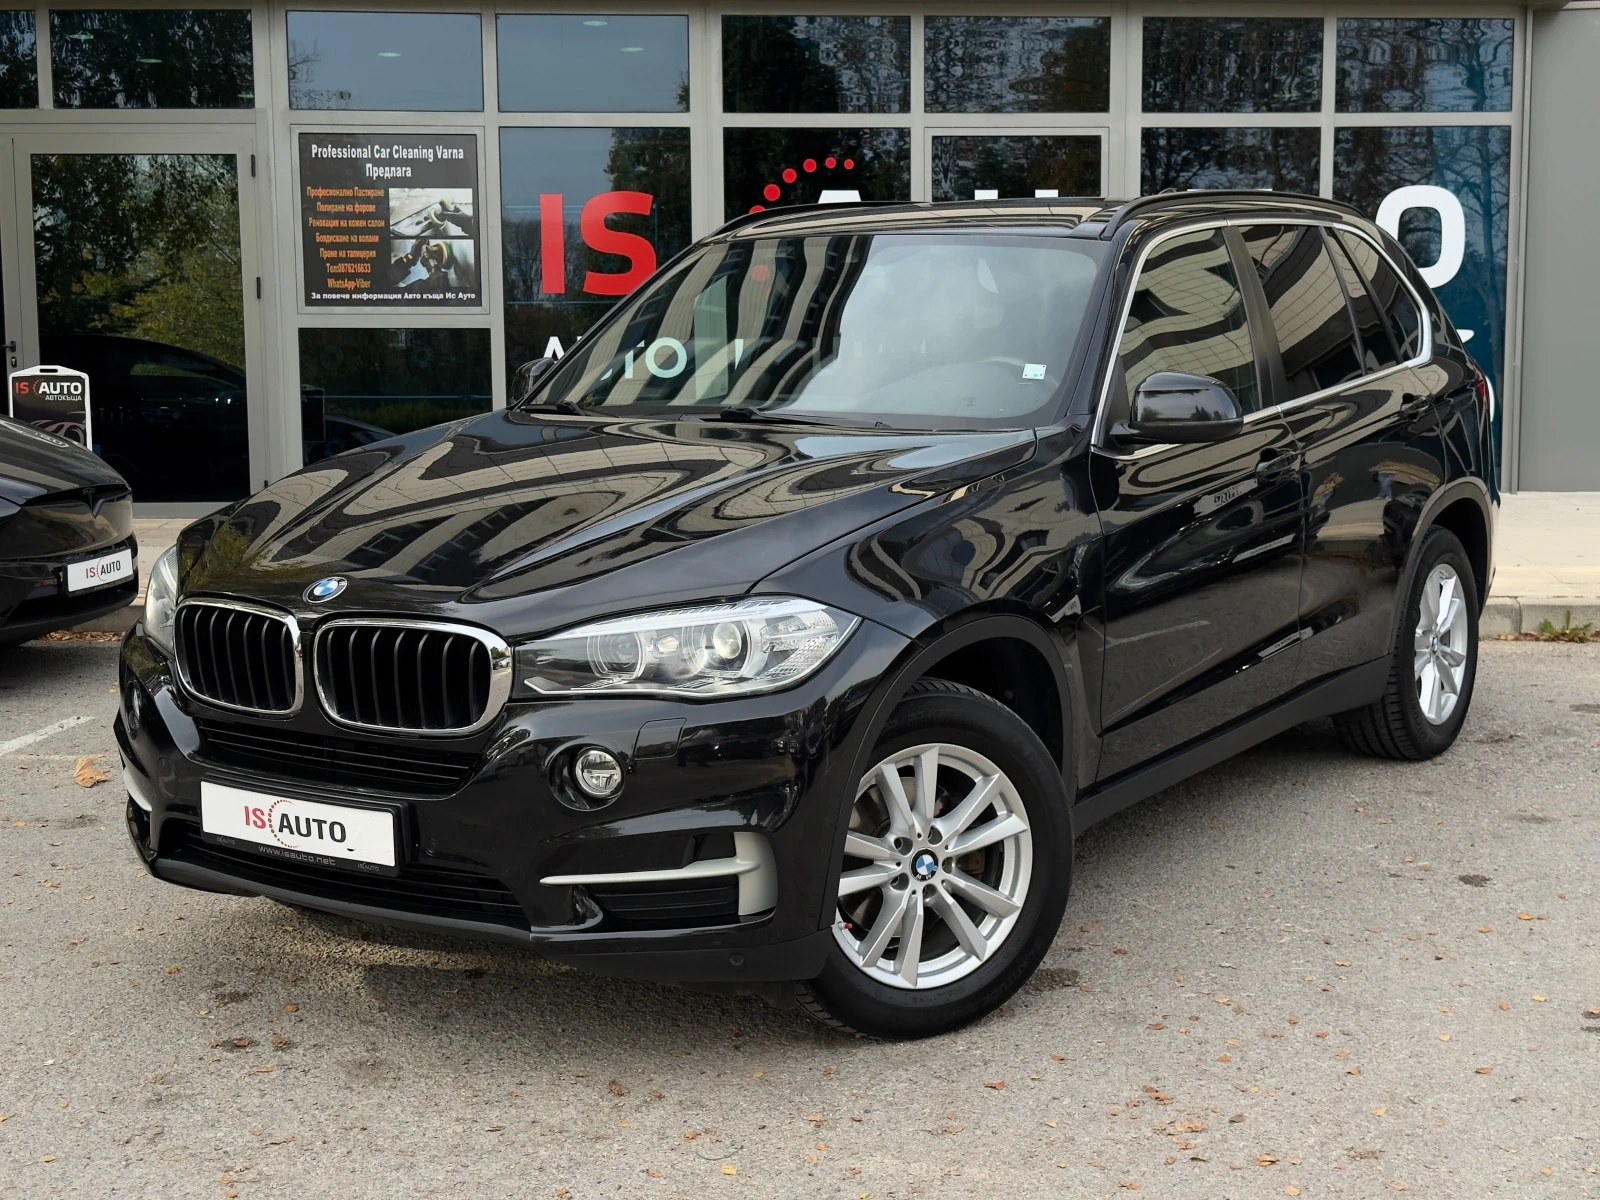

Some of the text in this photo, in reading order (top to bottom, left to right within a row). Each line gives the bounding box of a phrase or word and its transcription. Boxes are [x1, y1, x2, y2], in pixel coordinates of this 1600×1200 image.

[311, 144, 464, 162] Professional Car Cleaning Varna
[366, 163, 411, 180] Предлага
[316, 201, 376, 215] Полиране на фарове
[308, 217, 339, 229] Реновация
[340, 219, 347, 227] на
[367, 220, 385, 228] салон
[539, 190, 657, 295] IS
[319, 248, 338, 260] Пране
[351, 292, 401, 301] информация
[422, 293, 443, 301] къща
[445, 292, 456, 300] Ис
[457, 293, 476, 301] Ауто
[15, 382, 82, 395] IS AUTO
[85, 560, 121, 579] IS AUTO
[244, 805, 347, 843] IS AUTO
[258, 845, 336, 866] www.isauto.net
